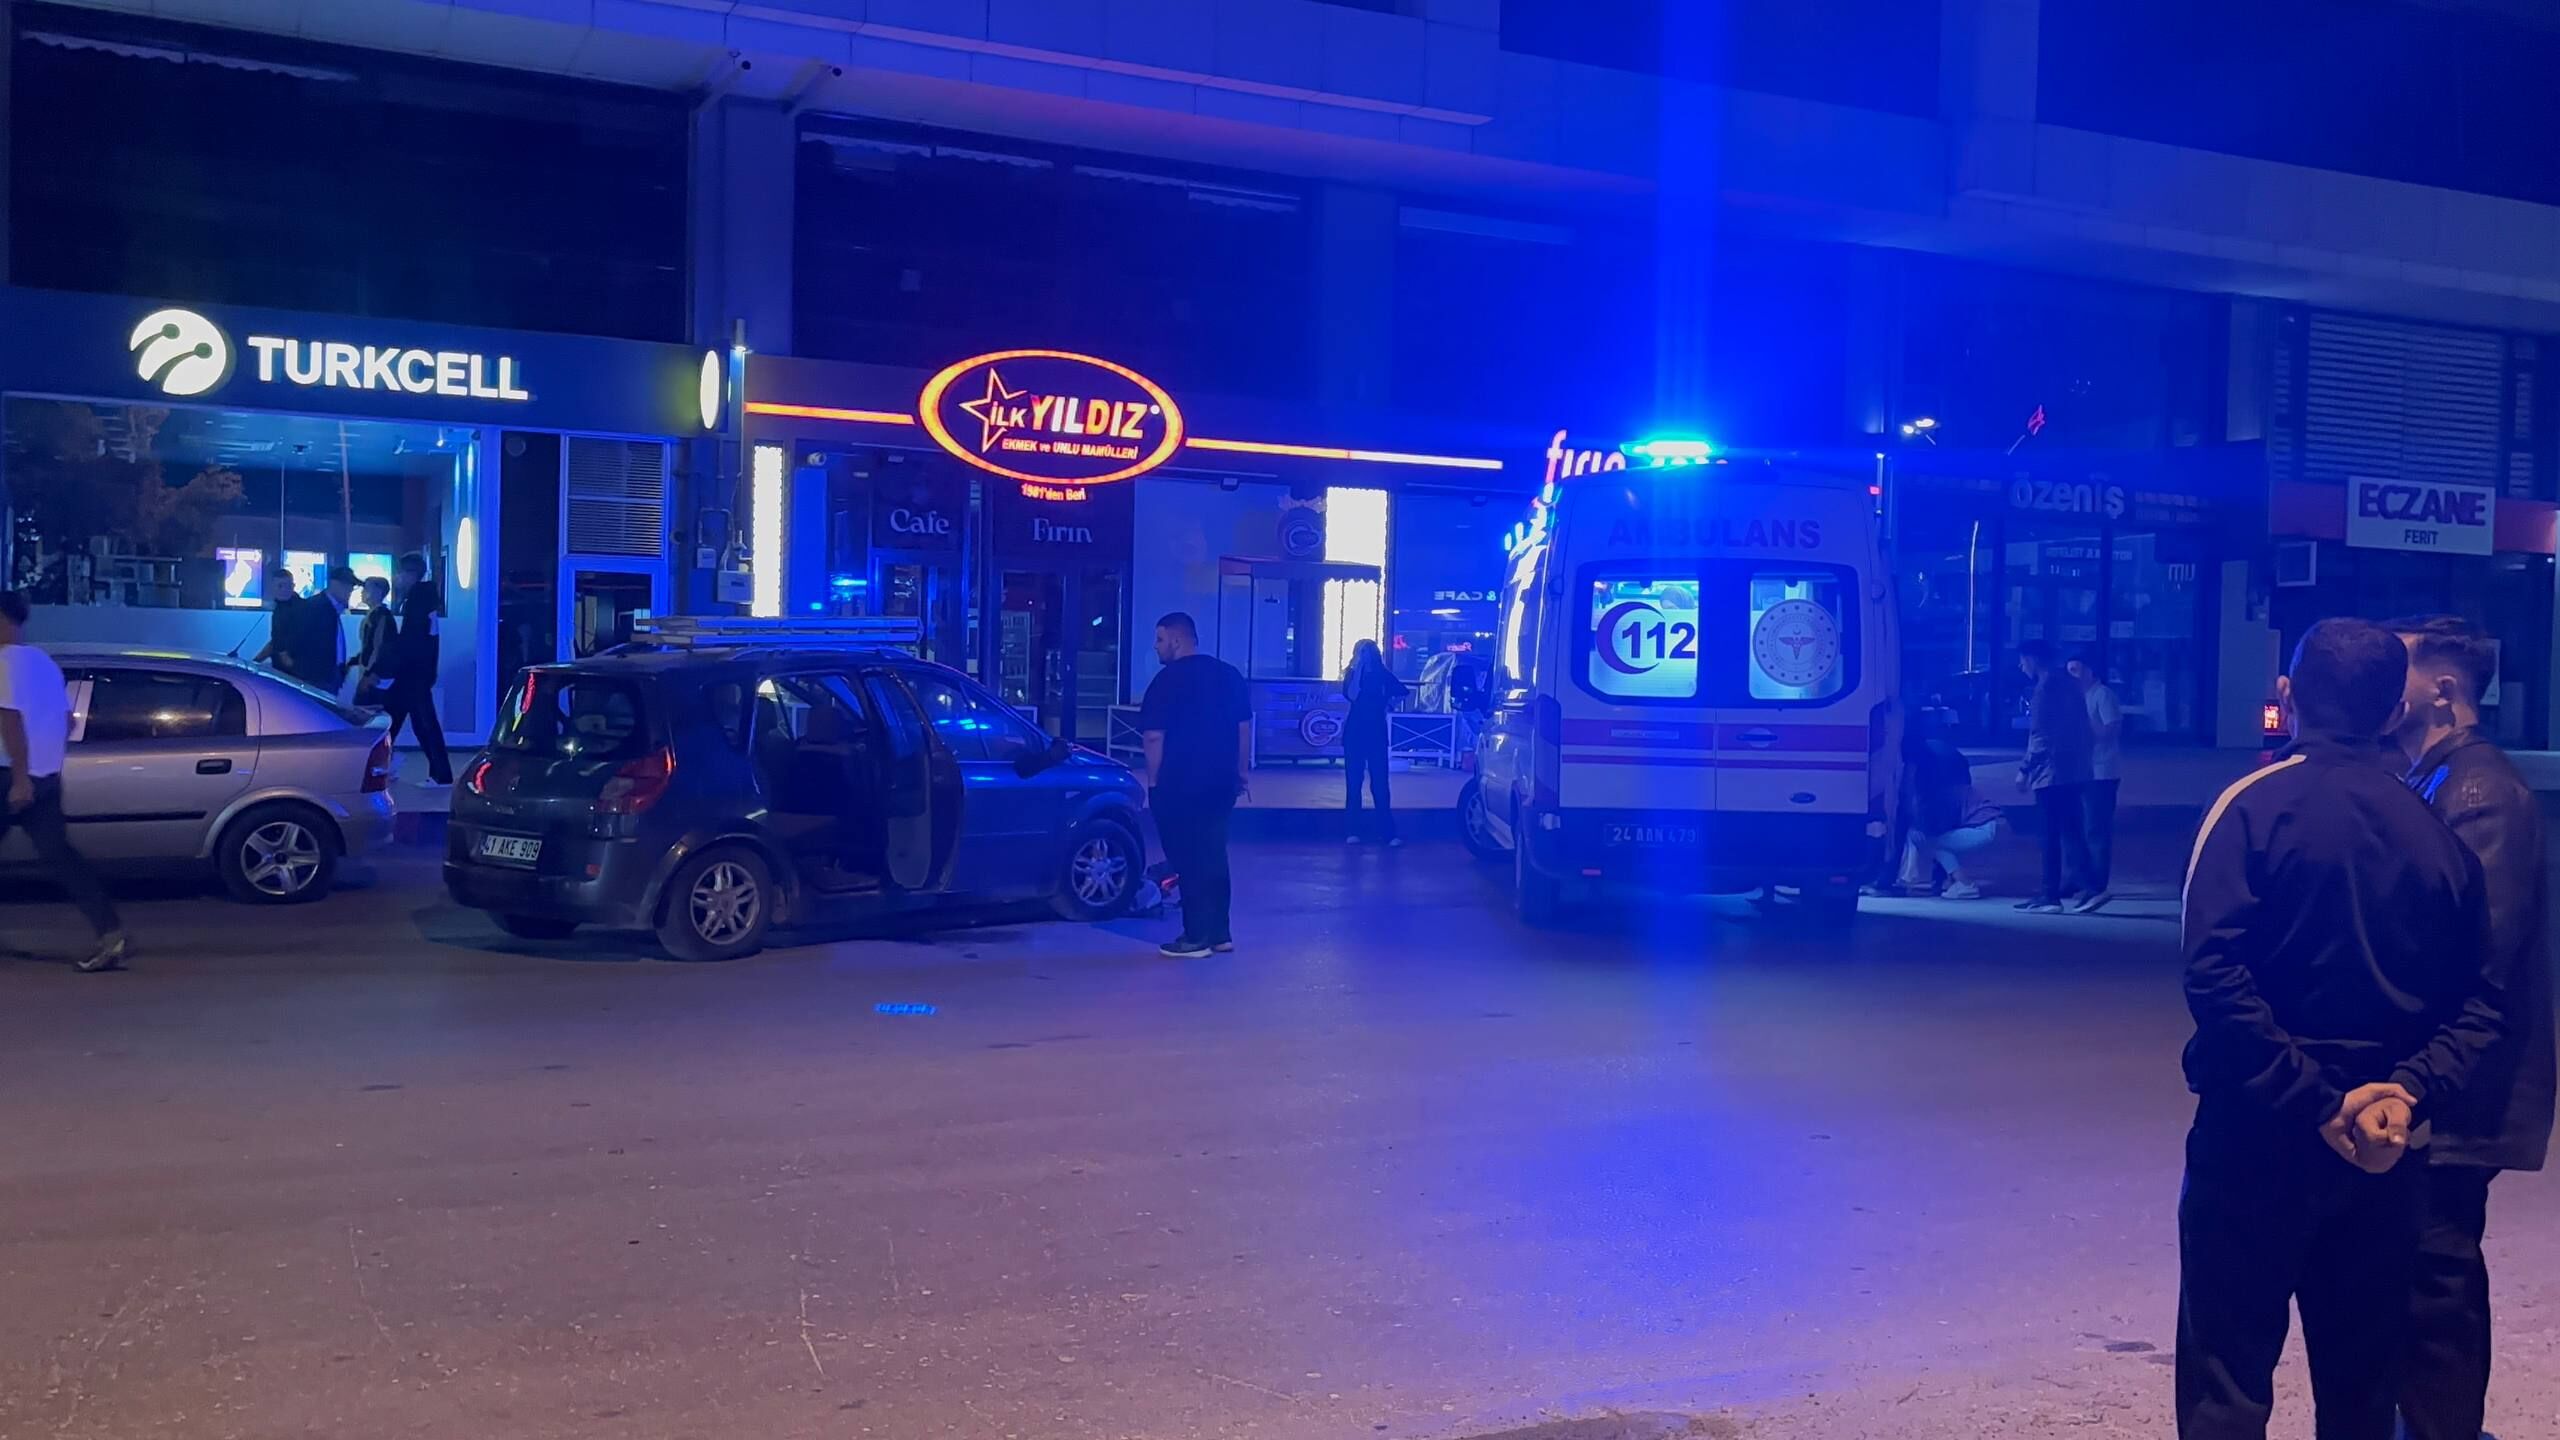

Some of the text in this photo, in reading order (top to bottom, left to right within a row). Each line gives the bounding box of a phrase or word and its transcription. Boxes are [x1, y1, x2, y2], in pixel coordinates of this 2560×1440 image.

[248, 335, 529, 401] TURKCELL
[989, 394, 1148, 439] İLK YILDIZ
[1002, 438, 1139, 460] EKMEK ve UNLU MAMÜLLERİ
[2358, 482, 2487, 527] ECZANE
[890, 508, 950, 535] Cafe
[1608, 518, 1822, 549] AMBULANS
[1621, 621, 1696, 659] 112
[498, 838, 518, 856] AKE
[1612, 826, 1632, 842] 24
